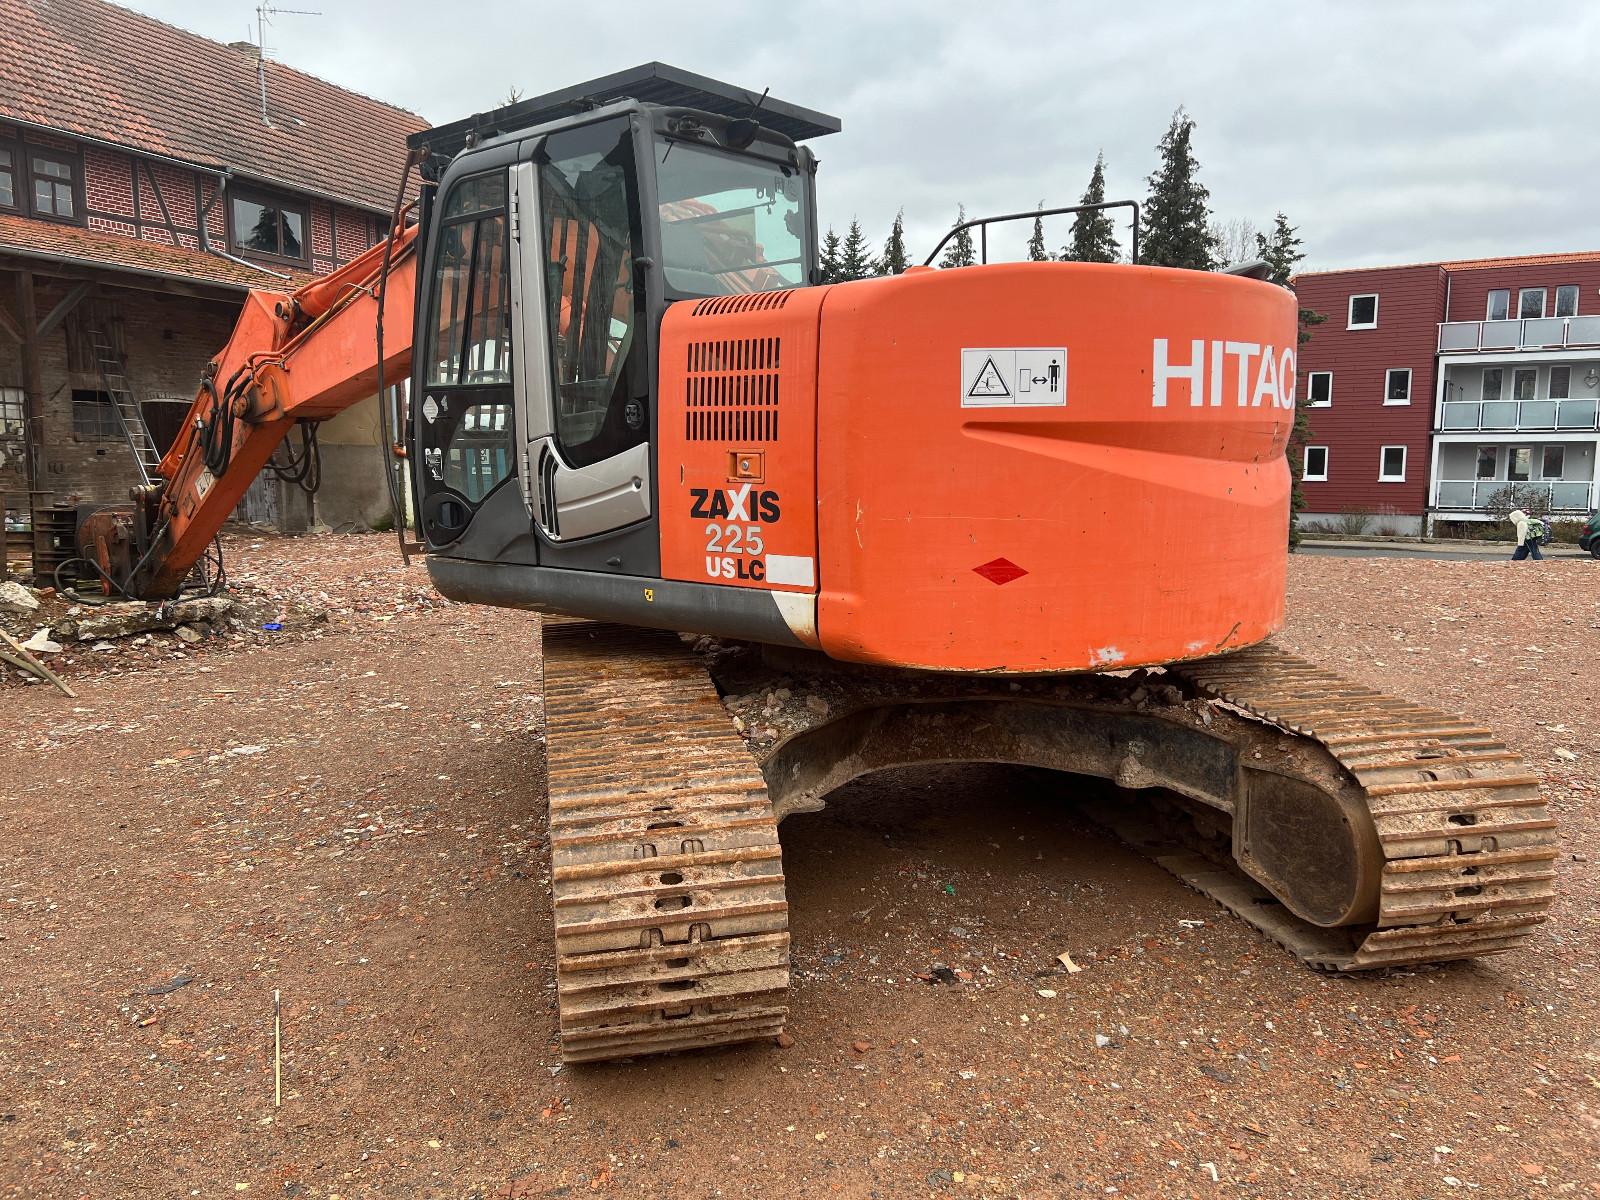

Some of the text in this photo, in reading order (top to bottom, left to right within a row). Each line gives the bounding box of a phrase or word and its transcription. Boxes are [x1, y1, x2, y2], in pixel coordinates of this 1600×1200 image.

[690, 483, 780, 523] ZAXIS
[705, 523, 764, 556] 225
[705, 556, 764, 581] USLC
